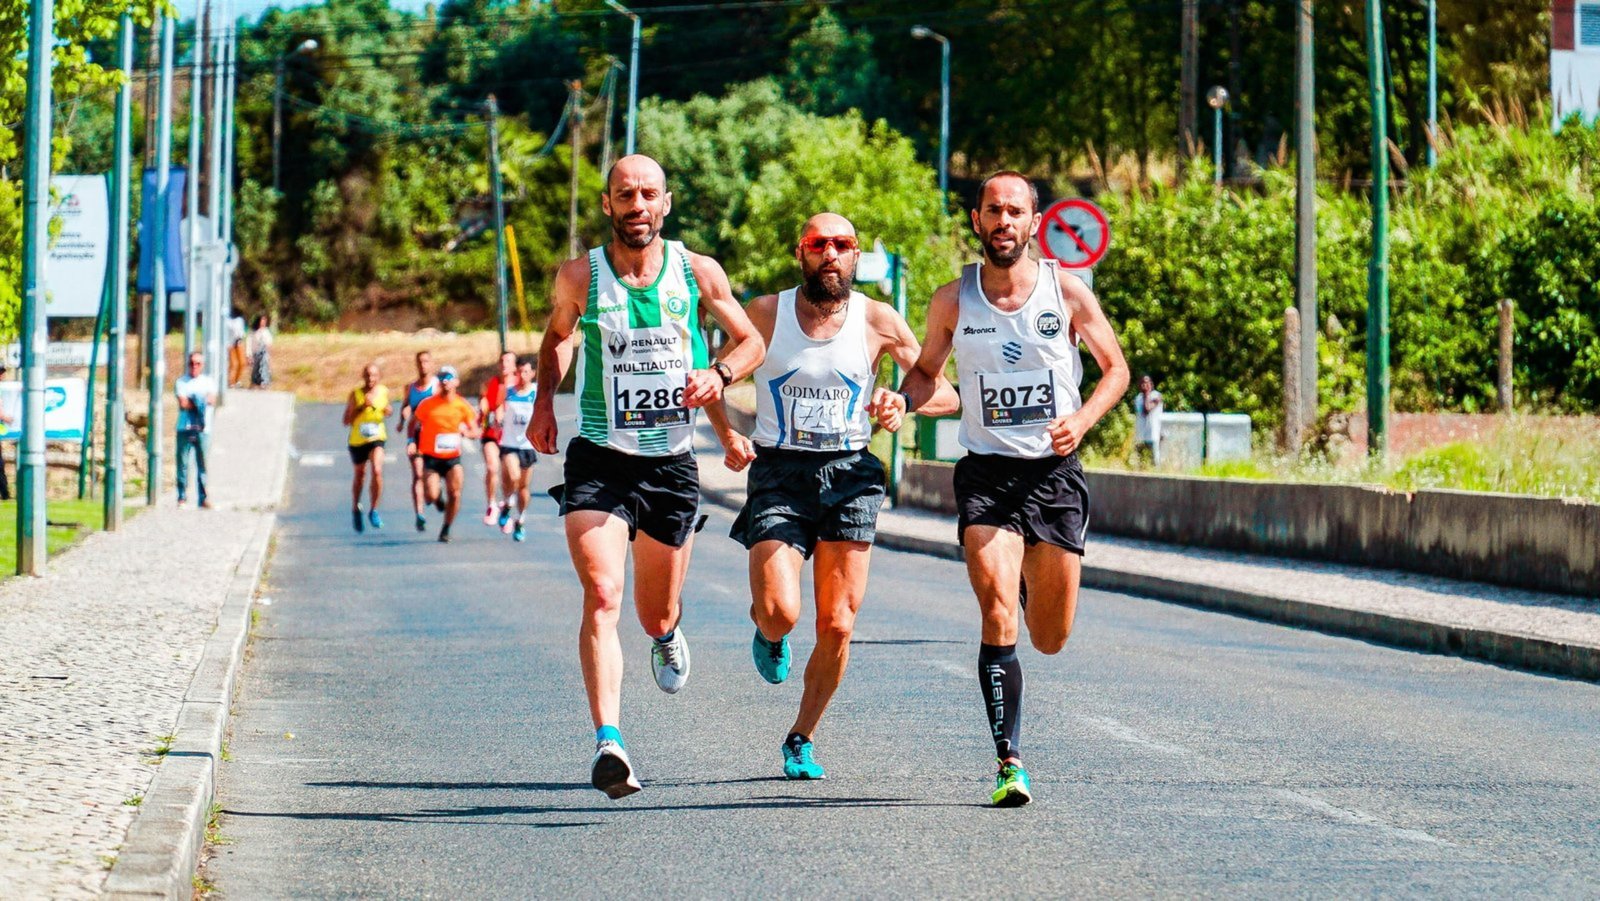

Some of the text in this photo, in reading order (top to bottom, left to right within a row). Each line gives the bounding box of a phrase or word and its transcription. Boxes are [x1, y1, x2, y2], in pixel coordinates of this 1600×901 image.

[1038, 323, 1059, 331] TEJO
[631, 337, 678, 347] RENAULT
[613, 359, 683, 374] MULTIAUTO
[618, 386, 685, 410] 1286
[782, 384, 850, 400] ODIMARO
[984, 383, 1052, 408] 2073
[986, 664, 1007, 736] kalenji
